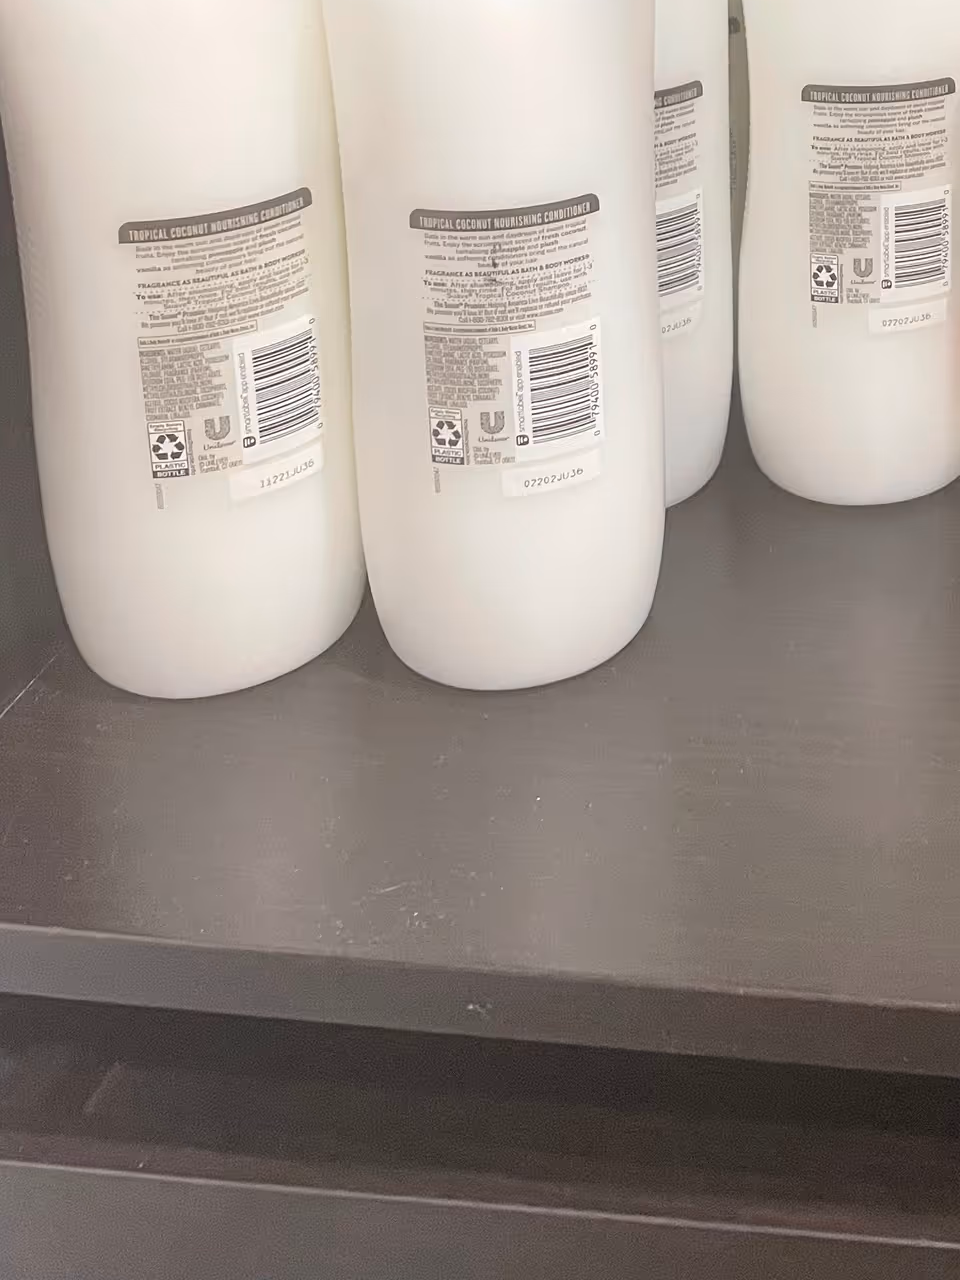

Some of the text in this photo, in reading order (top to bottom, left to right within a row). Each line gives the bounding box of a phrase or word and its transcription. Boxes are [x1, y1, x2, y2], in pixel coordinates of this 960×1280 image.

[810, 84, 948, 102] TROPICAL COCONUT NOURISHING CONDITIONER
[129, 197, 304, 241] TROPICAL COCONUT NOURISHING CONDITIONER
[420, 202, 590, 229] TROPICAL COCONUT NOURISHING CONDITIONER
[540, 239, 558, 248] plush
[541, 232, 559, 241] fresh
[138, 280, 181, 289] FRAGRANCE
[192, 273, 229, 284] BEAUTIFUL
[240, 265, 257, 275] BATH
[264, 258, 281, 268] BODY
[425, 269, 463, 277] FRAGRANCE
[521, 266, 538, 274] BATH
[545, 262, 562, 270] BODY
[661, 318, 691, 334] 02JU36
[308, 338, 319, 372] 58991
[589, 344, 598, 379] 58991
[312, 375, 321, 409] 79400
[590, 383, 600, 417] 79400
[433, 449, 462, 457] PLASTIC
[435, 456, 461, 464] BOTTLE
[154, 462, 186, 470] PLASTIC
[156, 470, 186, 478] BOTTLE
[260, 458, 315, 488] 11221JU36
[524, 468, 584, 488] 02202JU36
